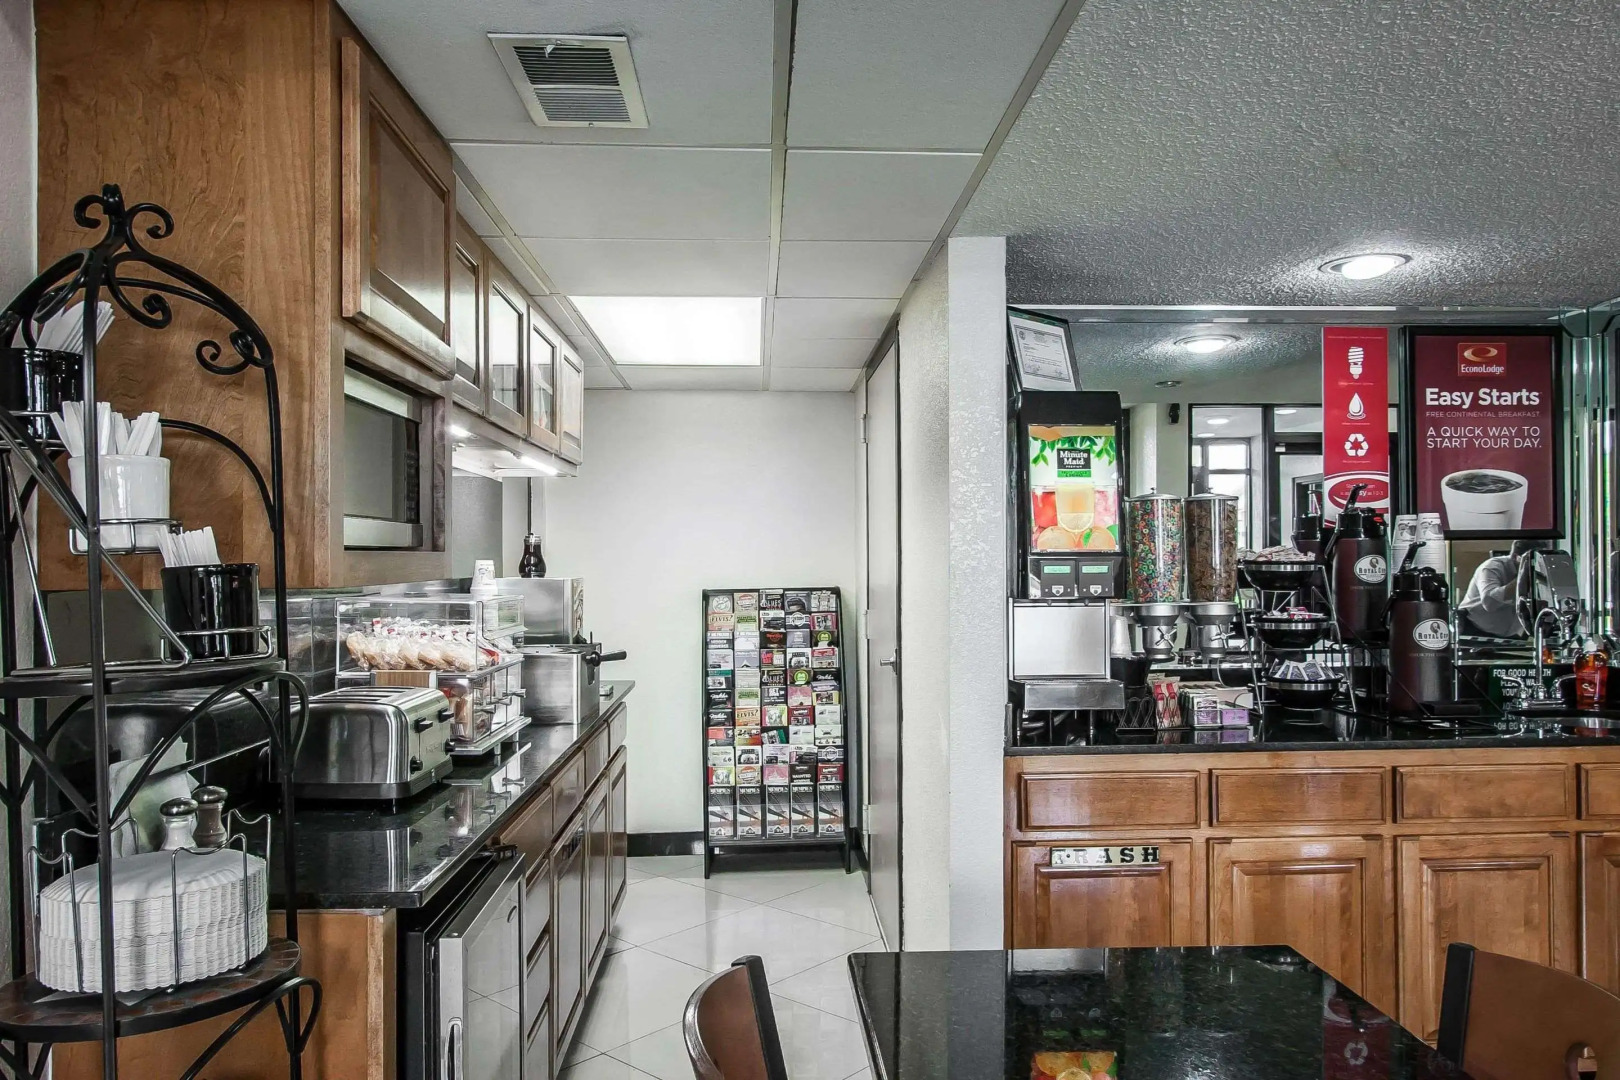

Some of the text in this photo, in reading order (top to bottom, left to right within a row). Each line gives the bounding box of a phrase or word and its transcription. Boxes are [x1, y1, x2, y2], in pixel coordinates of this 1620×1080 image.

[1461, 363, 1505, 375] EconoLodge
[1425, 387, 1540, 409] Easy Starts
[1426, 426, 1541, 437] A QUICK WAY TO
[1426, 438, 1542, 448] START YOUR DAY.
[1059, 450, 1089, 459] Minute
[1063, 457, 1085, 465] Maid
[1418, 632, 1439, 640] ROYAL
[1493, 668, 1507, 677] FOR
[1508, 668, 1527, 677] GOOD
